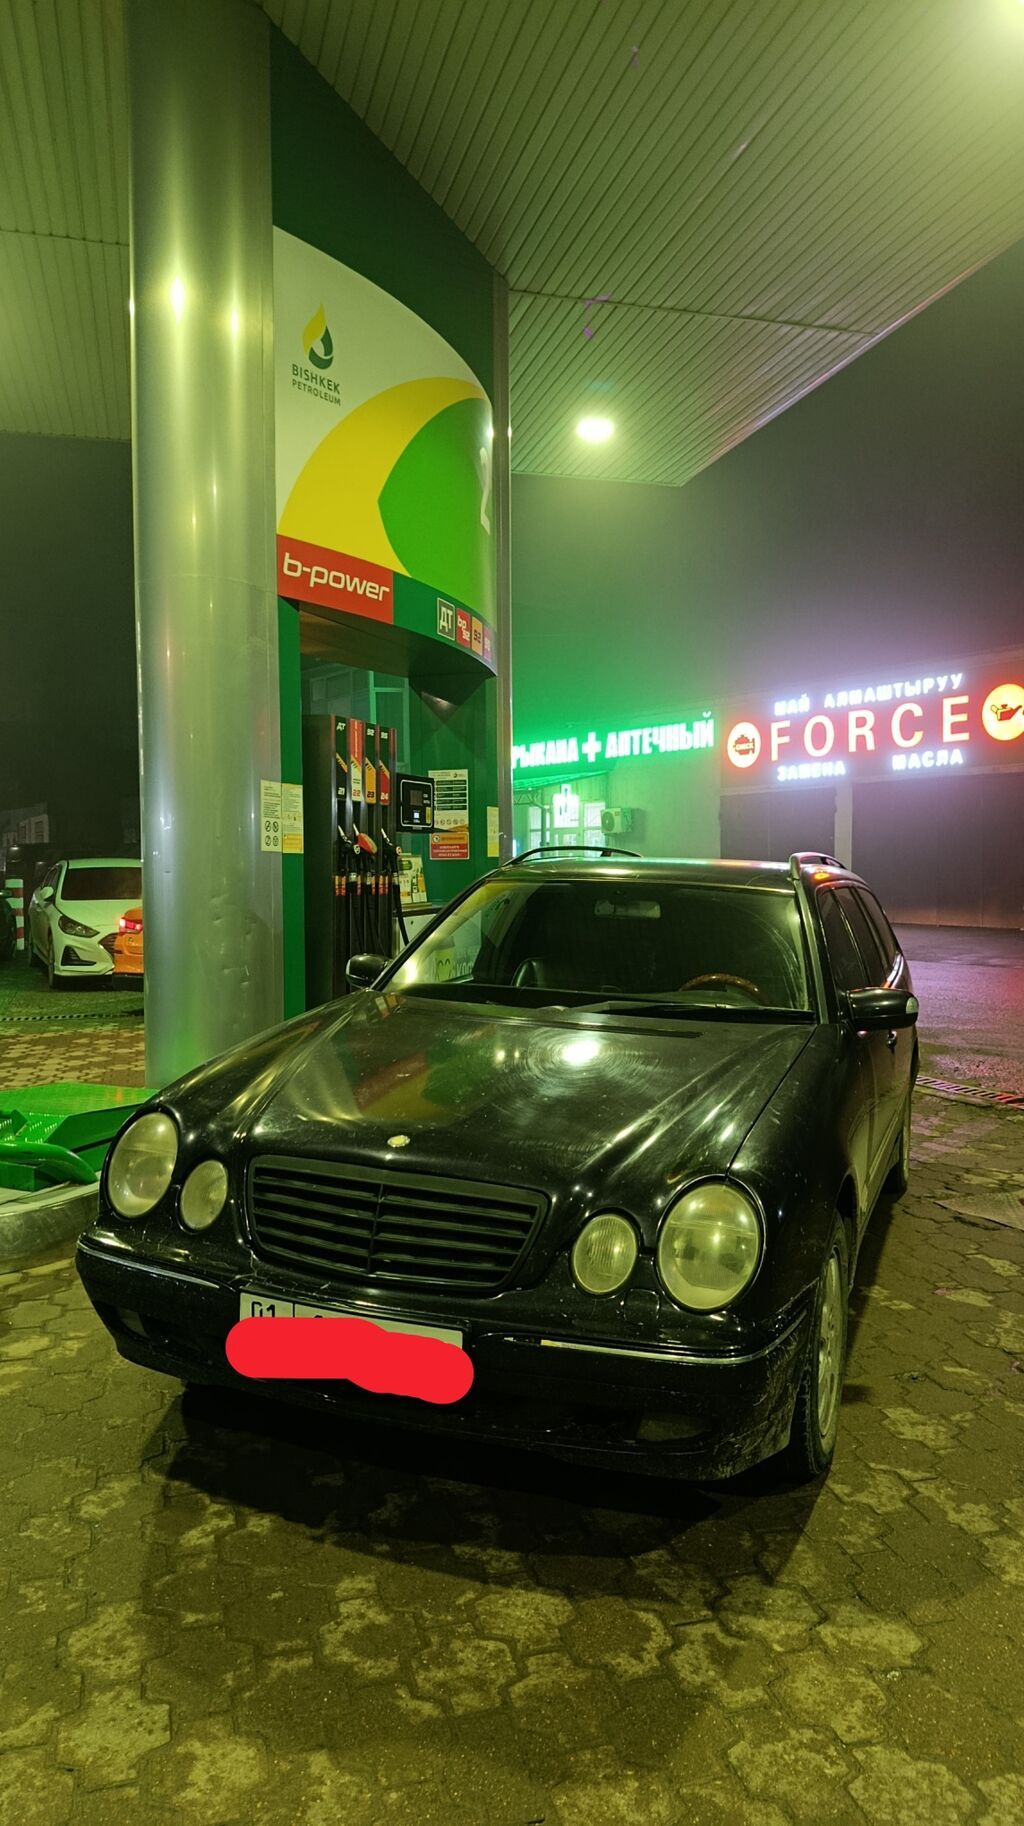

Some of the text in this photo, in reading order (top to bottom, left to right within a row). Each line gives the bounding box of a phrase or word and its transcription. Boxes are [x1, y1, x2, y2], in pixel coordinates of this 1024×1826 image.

[292, 363, 340, 394] BISHKEK
[292, 379, 341, 406] PETROLEUM
[283, 552, 390, 601] b-power
[440, 606, 453, 633] ДТ
[605, 711, 714, 759] АПТЕЧНЫЙ
[770, 695, 970, 761] FORCE
[892, 748, 964, 770] МАСЛА
